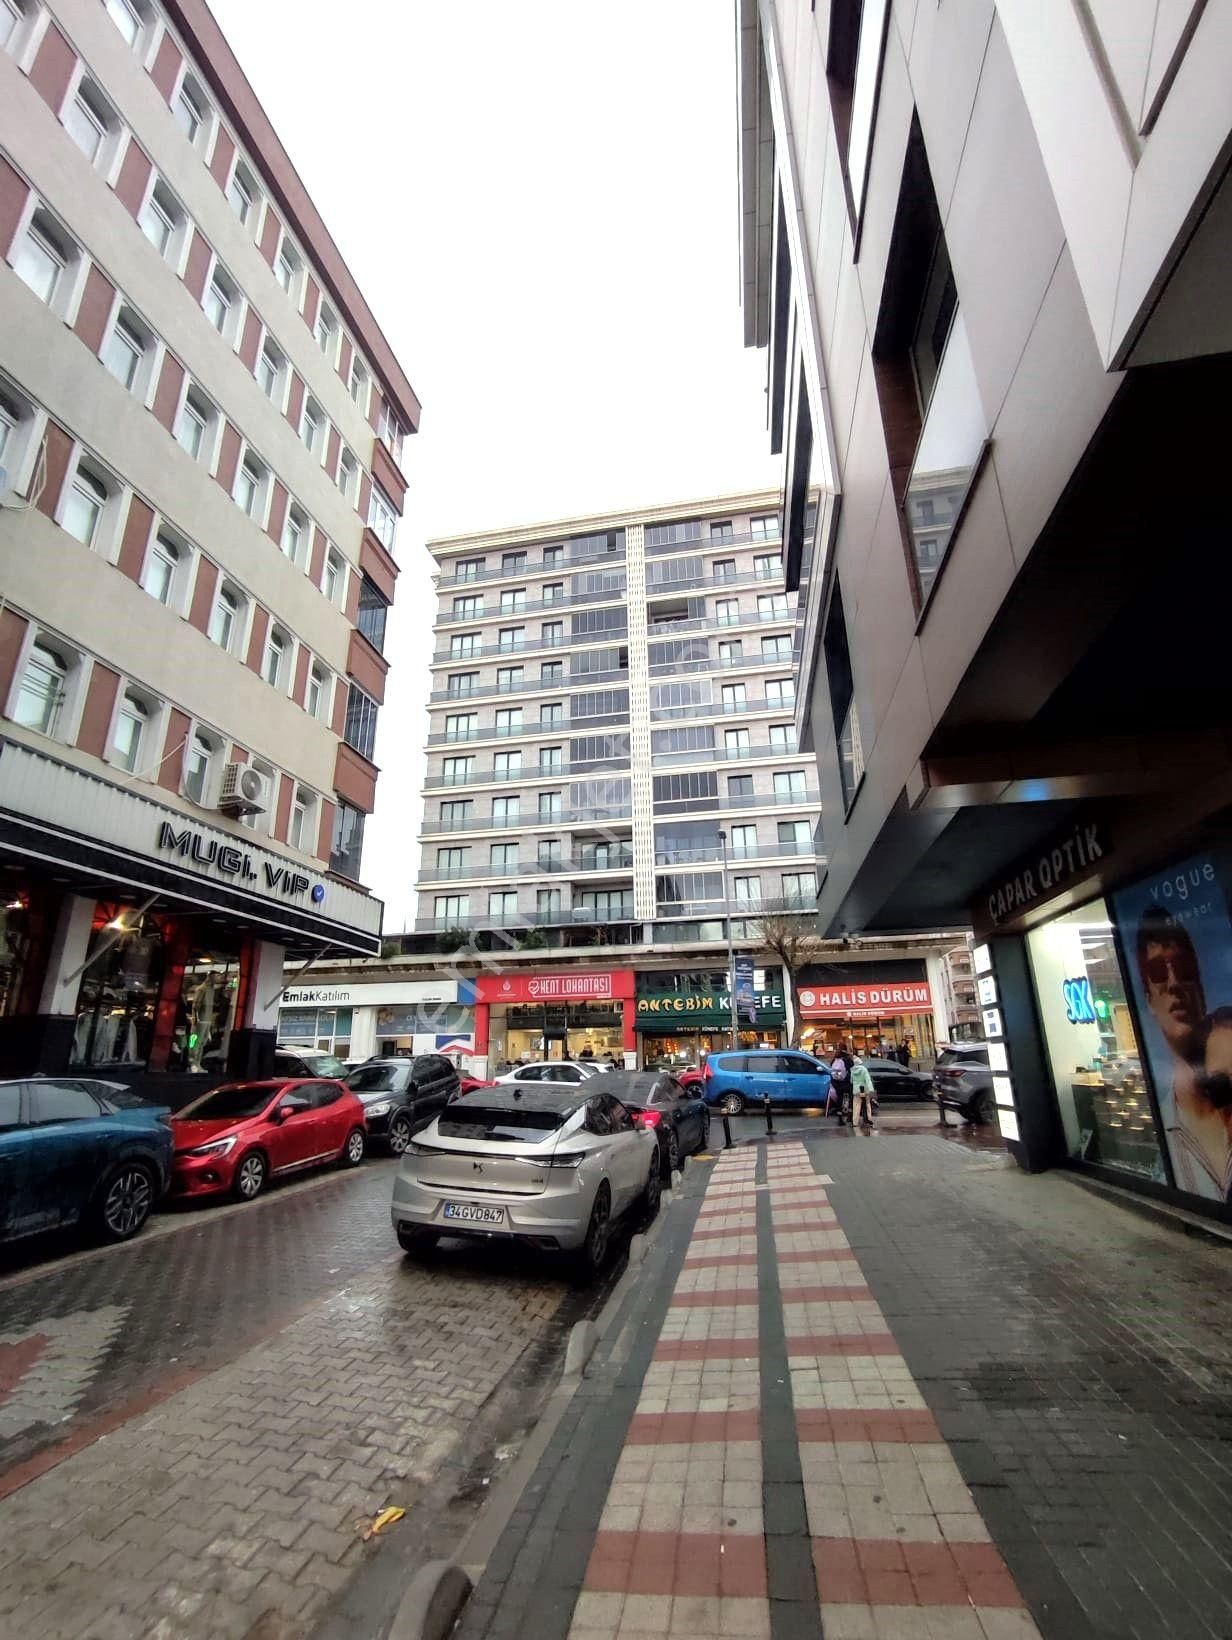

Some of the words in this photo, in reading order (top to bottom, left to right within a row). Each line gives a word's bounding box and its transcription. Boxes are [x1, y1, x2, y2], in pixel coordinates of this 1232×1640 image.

[1149, 863, 1215, 901] vogue
[718, 995, 782, 1010] KEFE
[819, 989, 867, 1006] HALİS
[870, 987, 928, 1004] DÜRÜM
